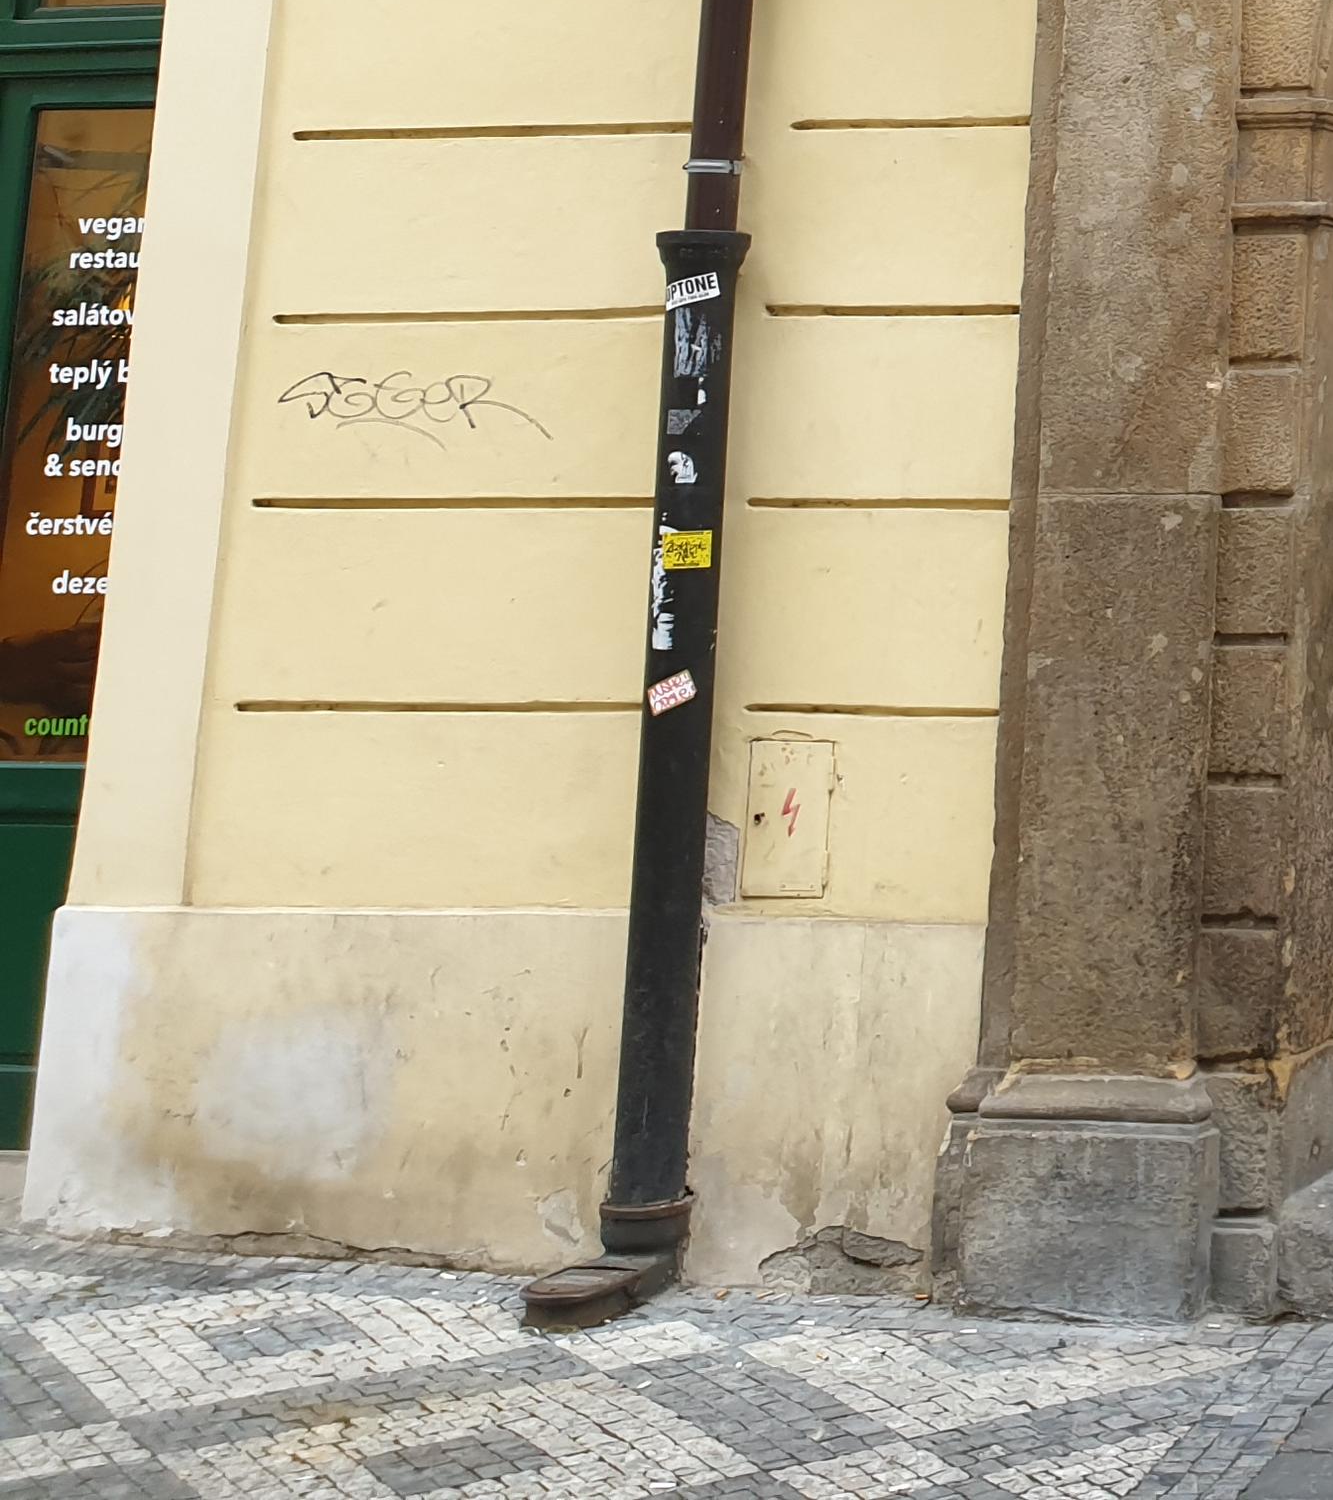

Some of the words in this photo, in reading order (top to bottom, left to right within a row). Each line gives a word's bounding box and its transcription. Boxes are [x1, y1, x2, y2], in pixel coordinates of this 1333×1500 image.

[49, 359, 112, 390] teplý
[66, 417, 123, 448] burg
[44, 453, 63, 477] &
[26, 512, 113, 535] čerstvé
[52, 570, 108, 594] deze
